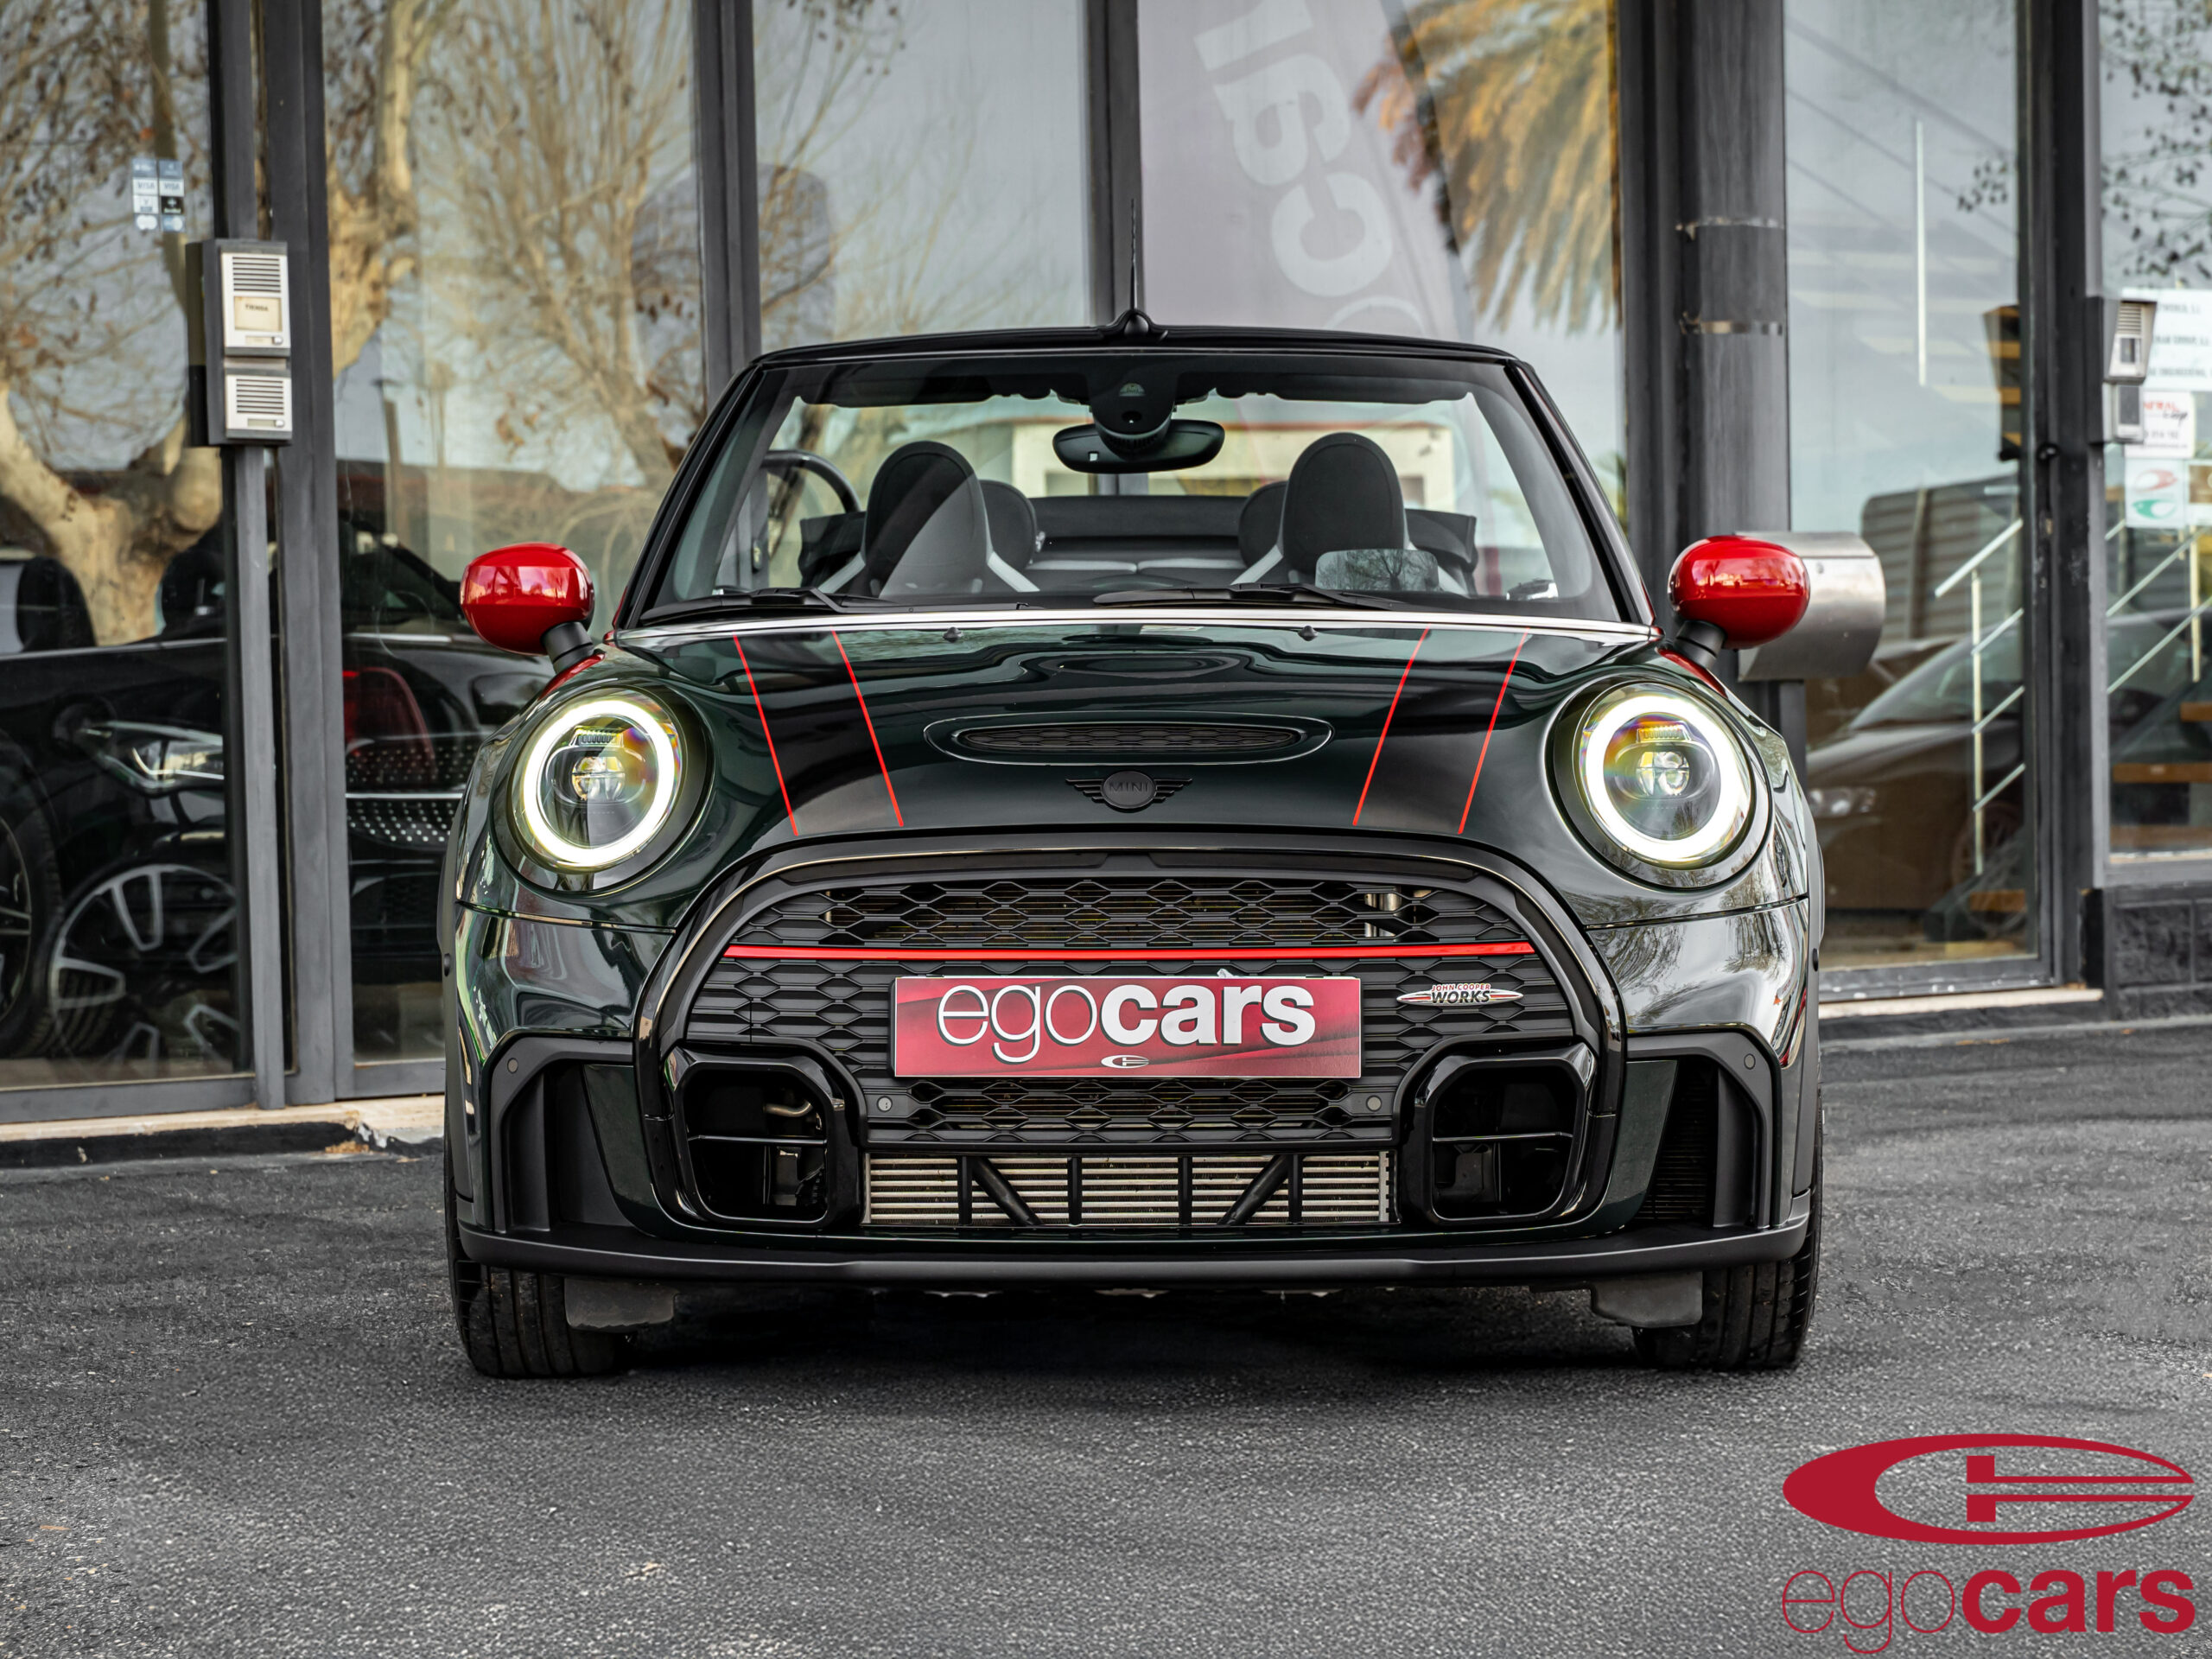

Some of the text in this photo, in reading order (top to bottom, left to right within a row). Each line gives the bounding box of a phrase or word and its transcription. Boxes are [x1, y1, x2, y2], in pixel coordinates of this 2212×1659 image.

[137, 181, 156, 189] VISA
[1109, 781, 1149, 792] MINI
[1432, 991, 1491, 1003] WORKS
[937, 984, 1316, 1065] egocars
